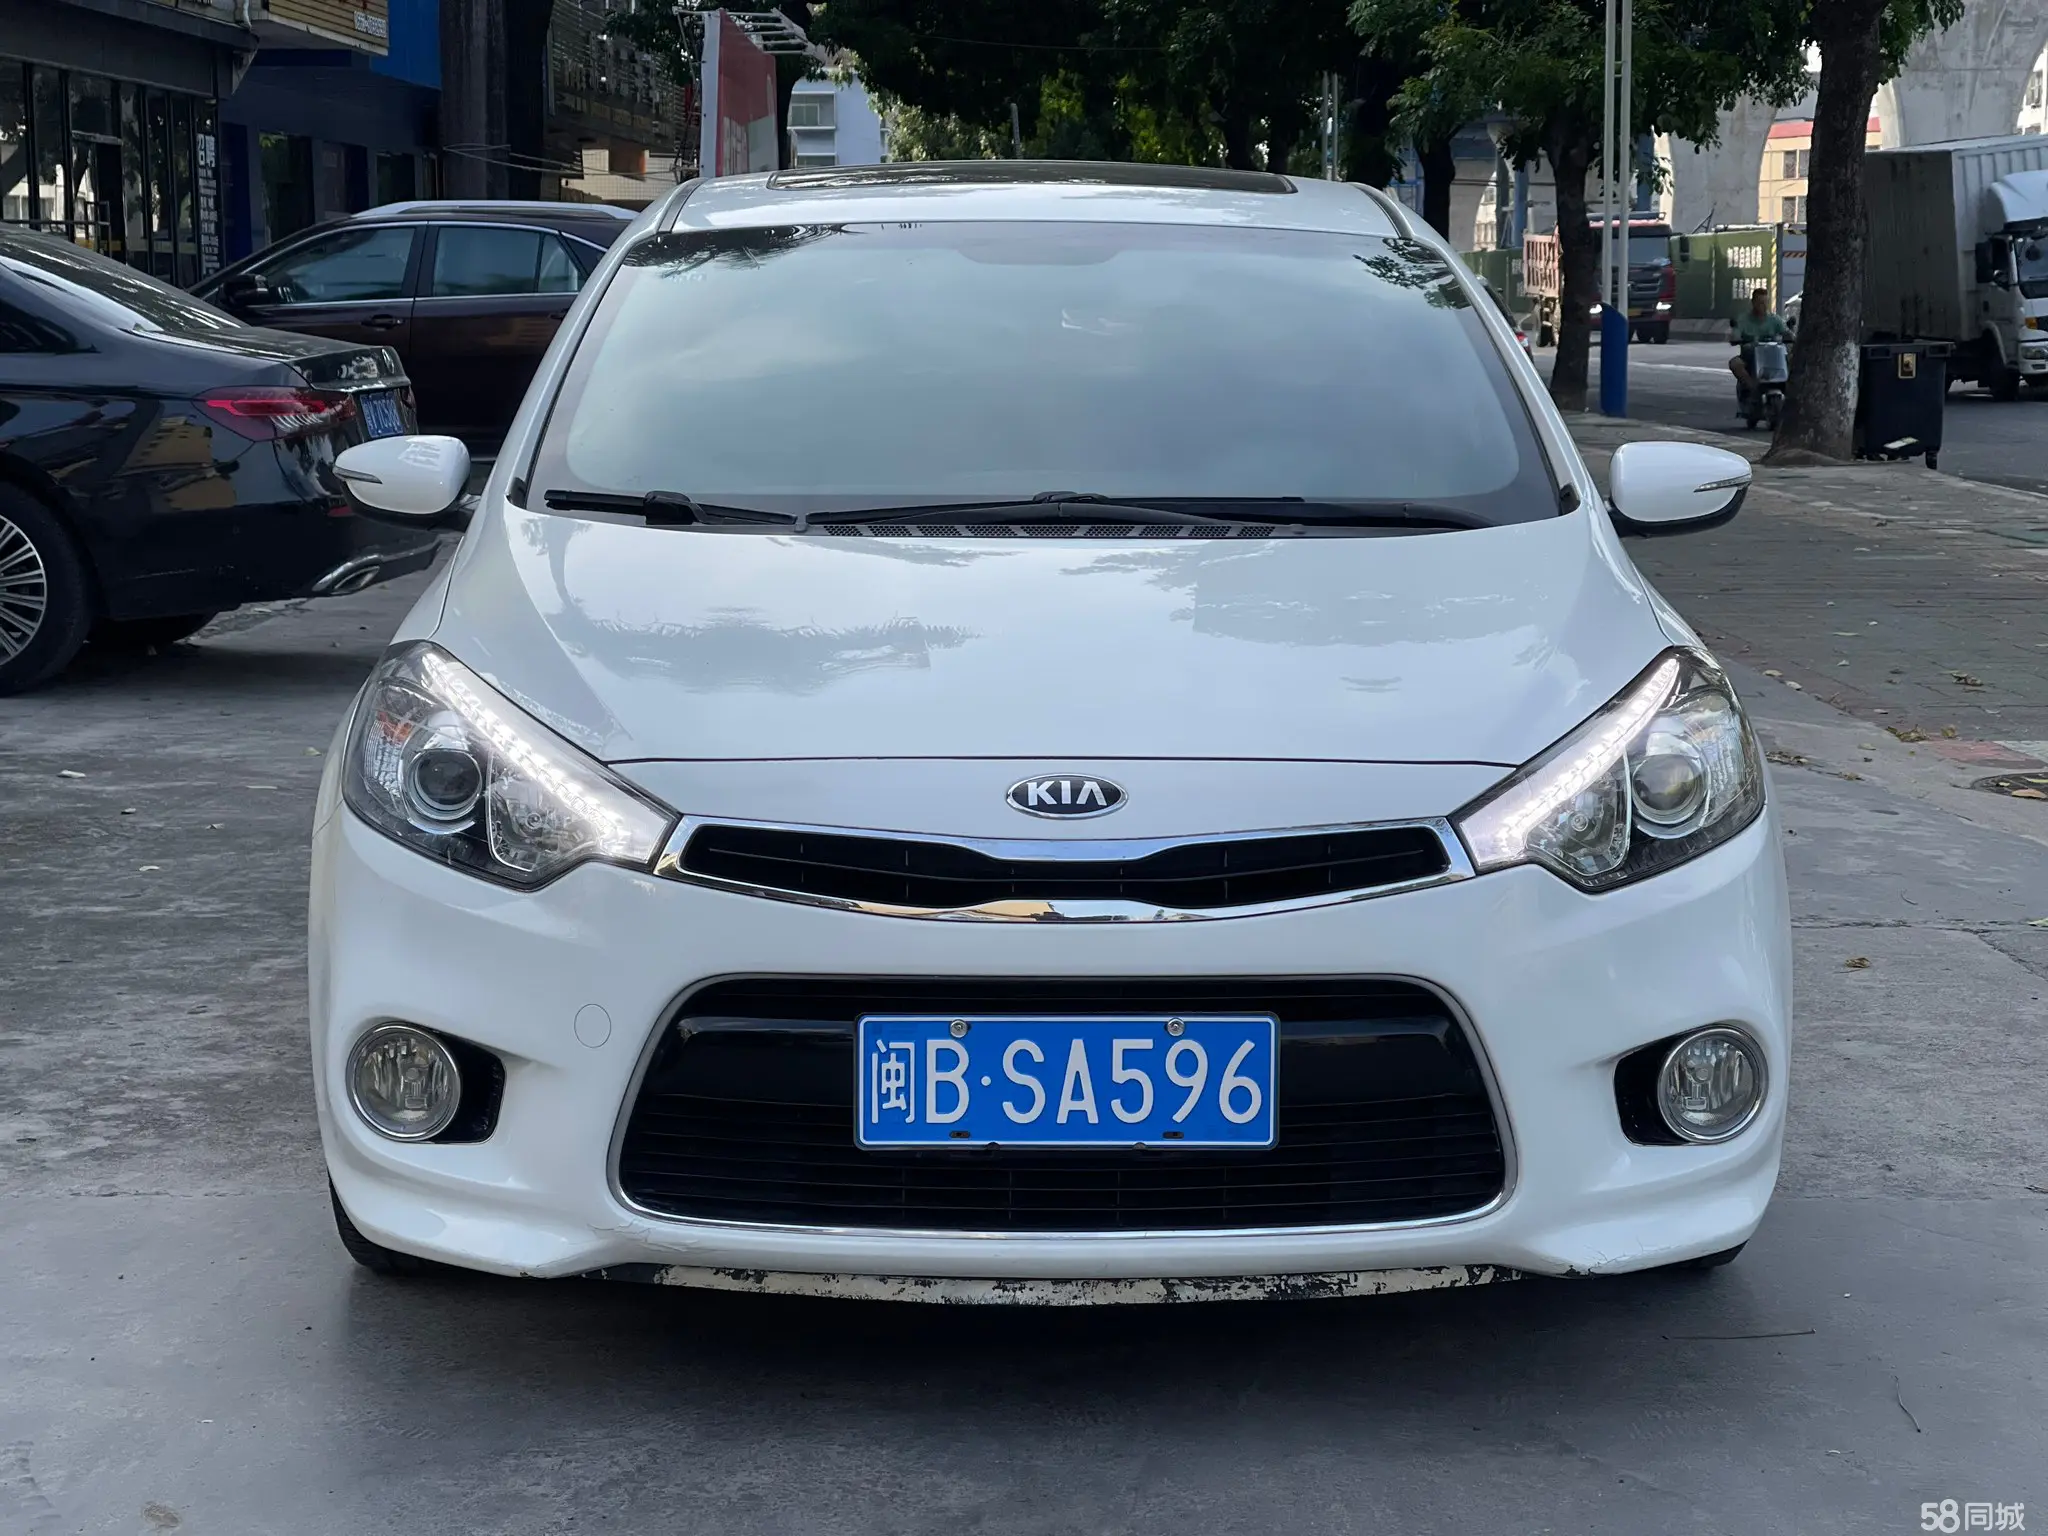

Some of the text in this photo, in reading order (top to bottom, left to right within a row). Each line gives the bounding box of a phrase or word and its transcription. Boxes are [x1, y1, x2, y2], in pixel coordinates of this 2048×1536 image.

[196, 133, 216, 168] 招聘
[1026, 780, 1108, 806] KIA
[871, 1038, 1263, 1124] 闽B·SA596
